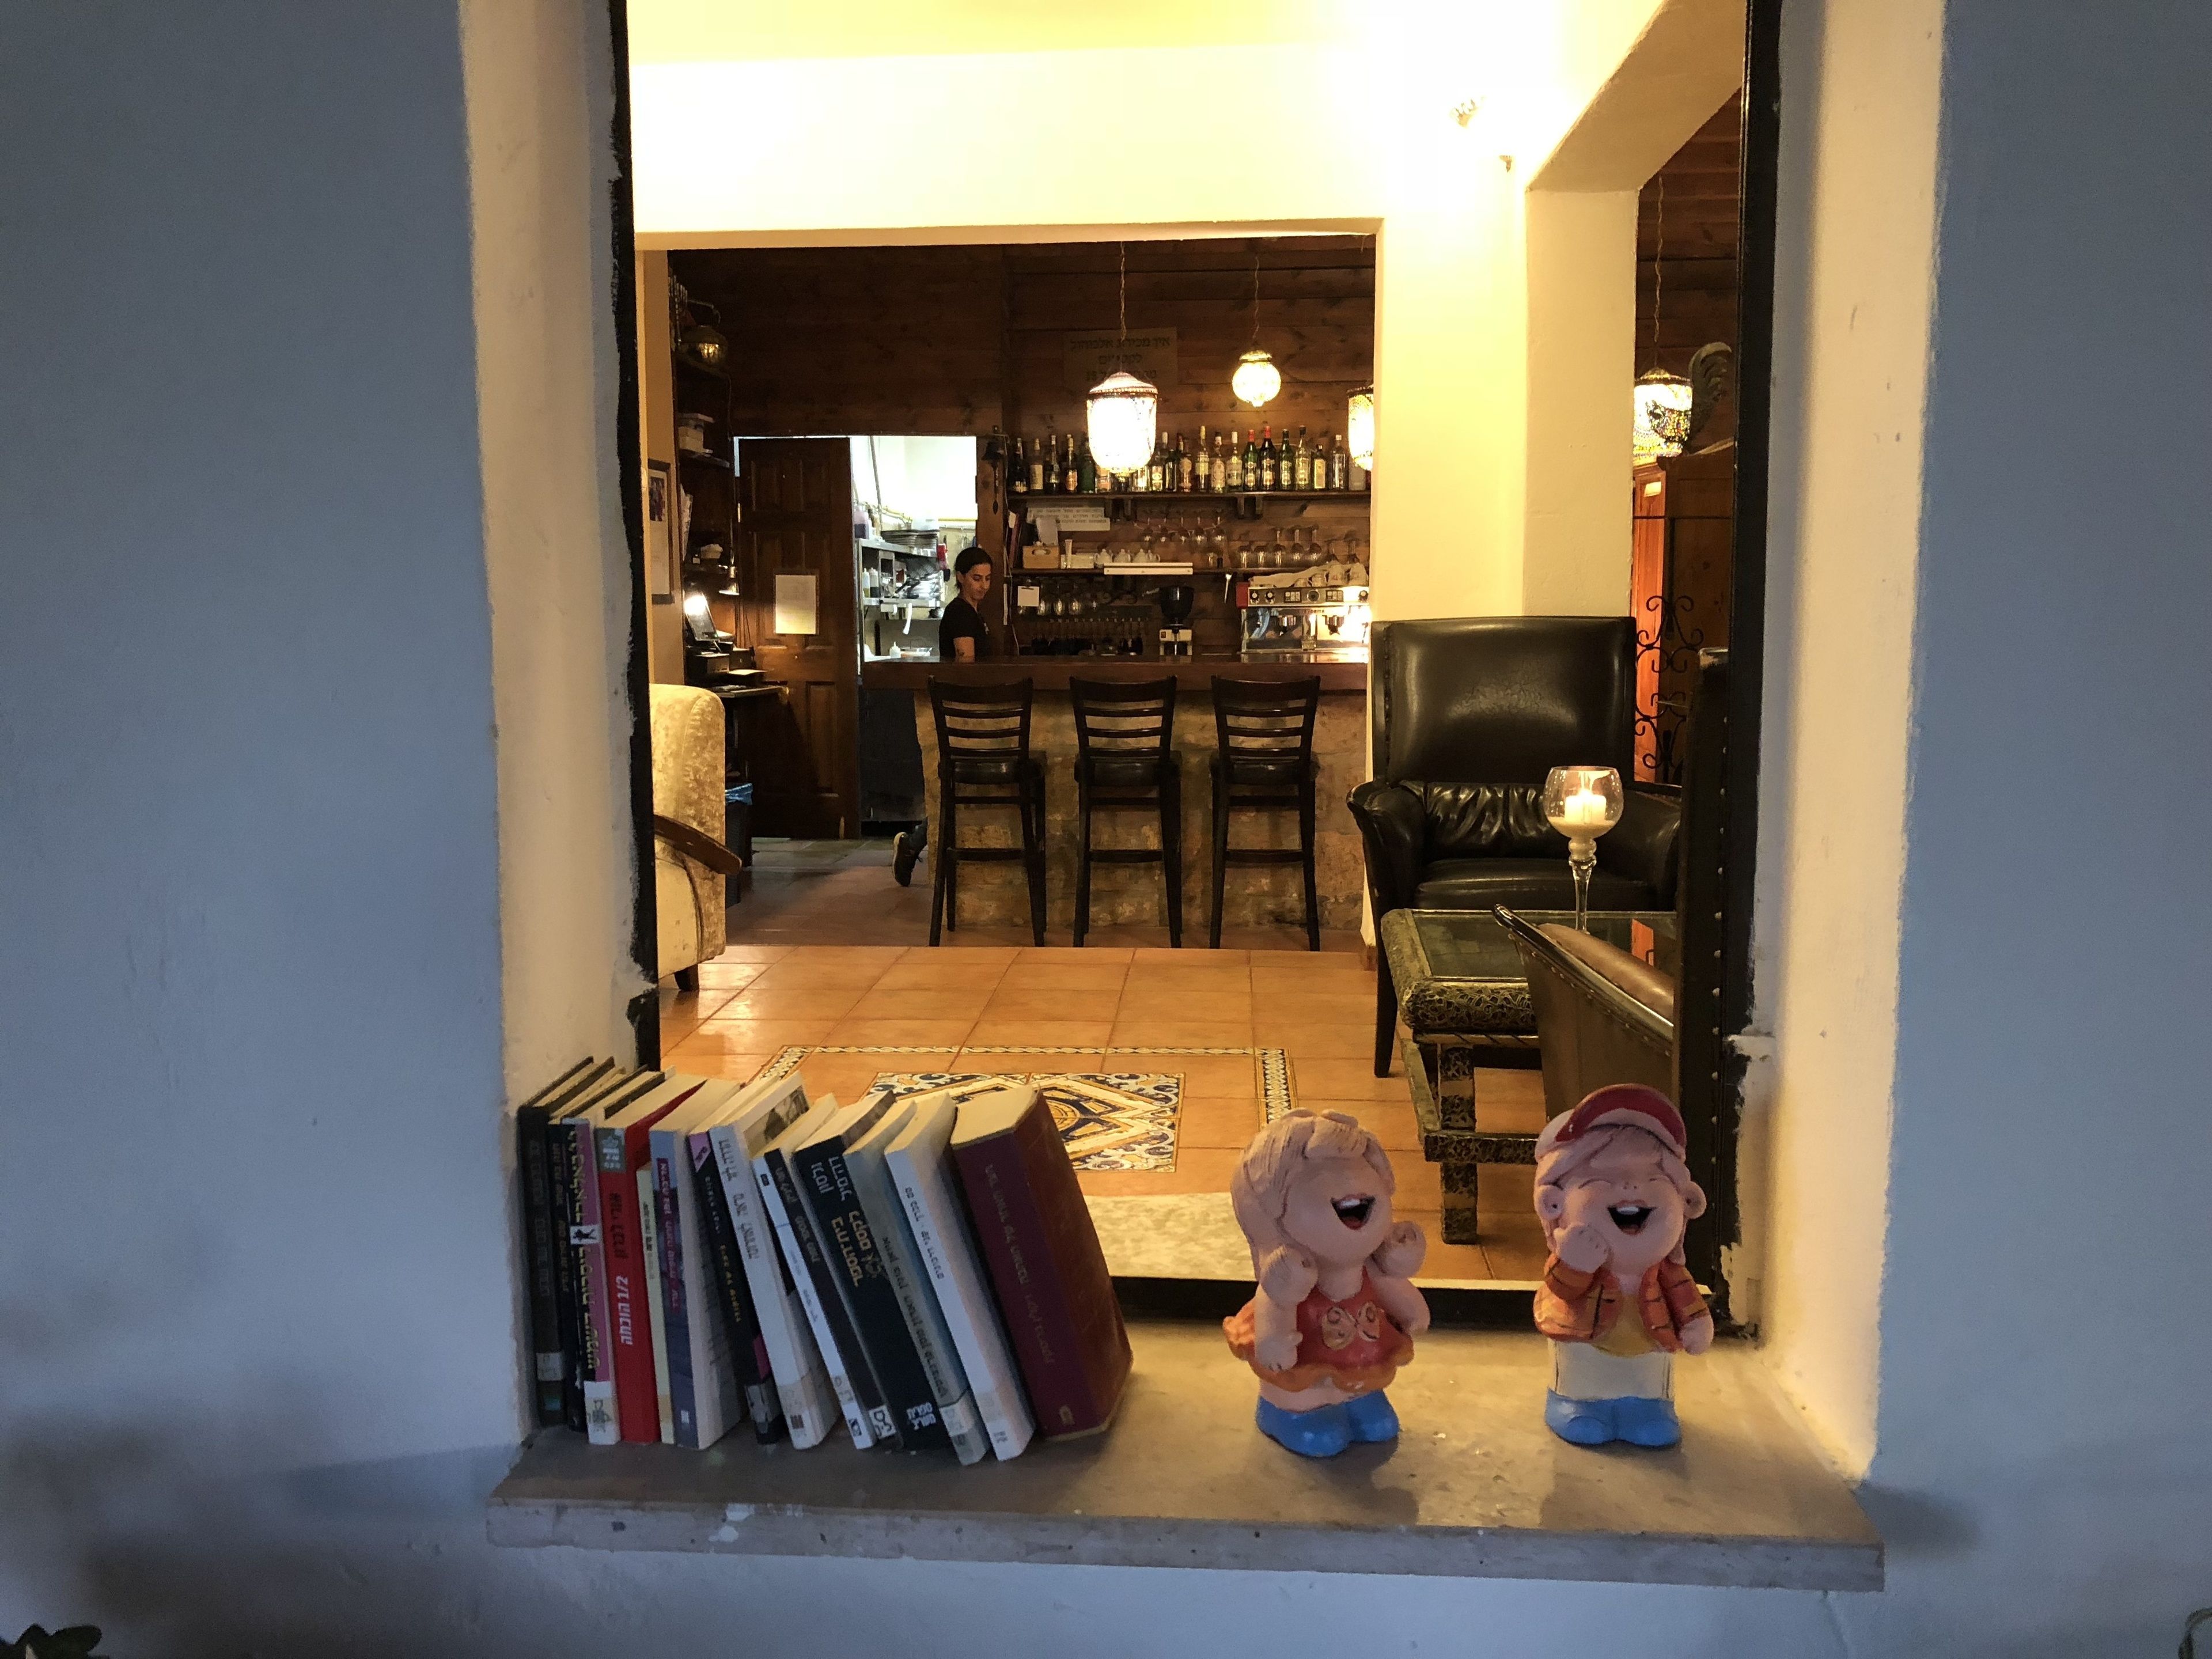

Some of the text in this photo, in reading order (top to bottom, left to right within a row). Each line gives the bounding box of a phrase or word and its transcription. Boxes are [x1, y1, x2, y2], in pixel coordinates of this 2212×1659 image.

[811, 1161, 835, 1194] נלסון
[849, 1210, 872, 1251] לקסם
[615, 1274, 634, 1346] 1/2 הוכחה
